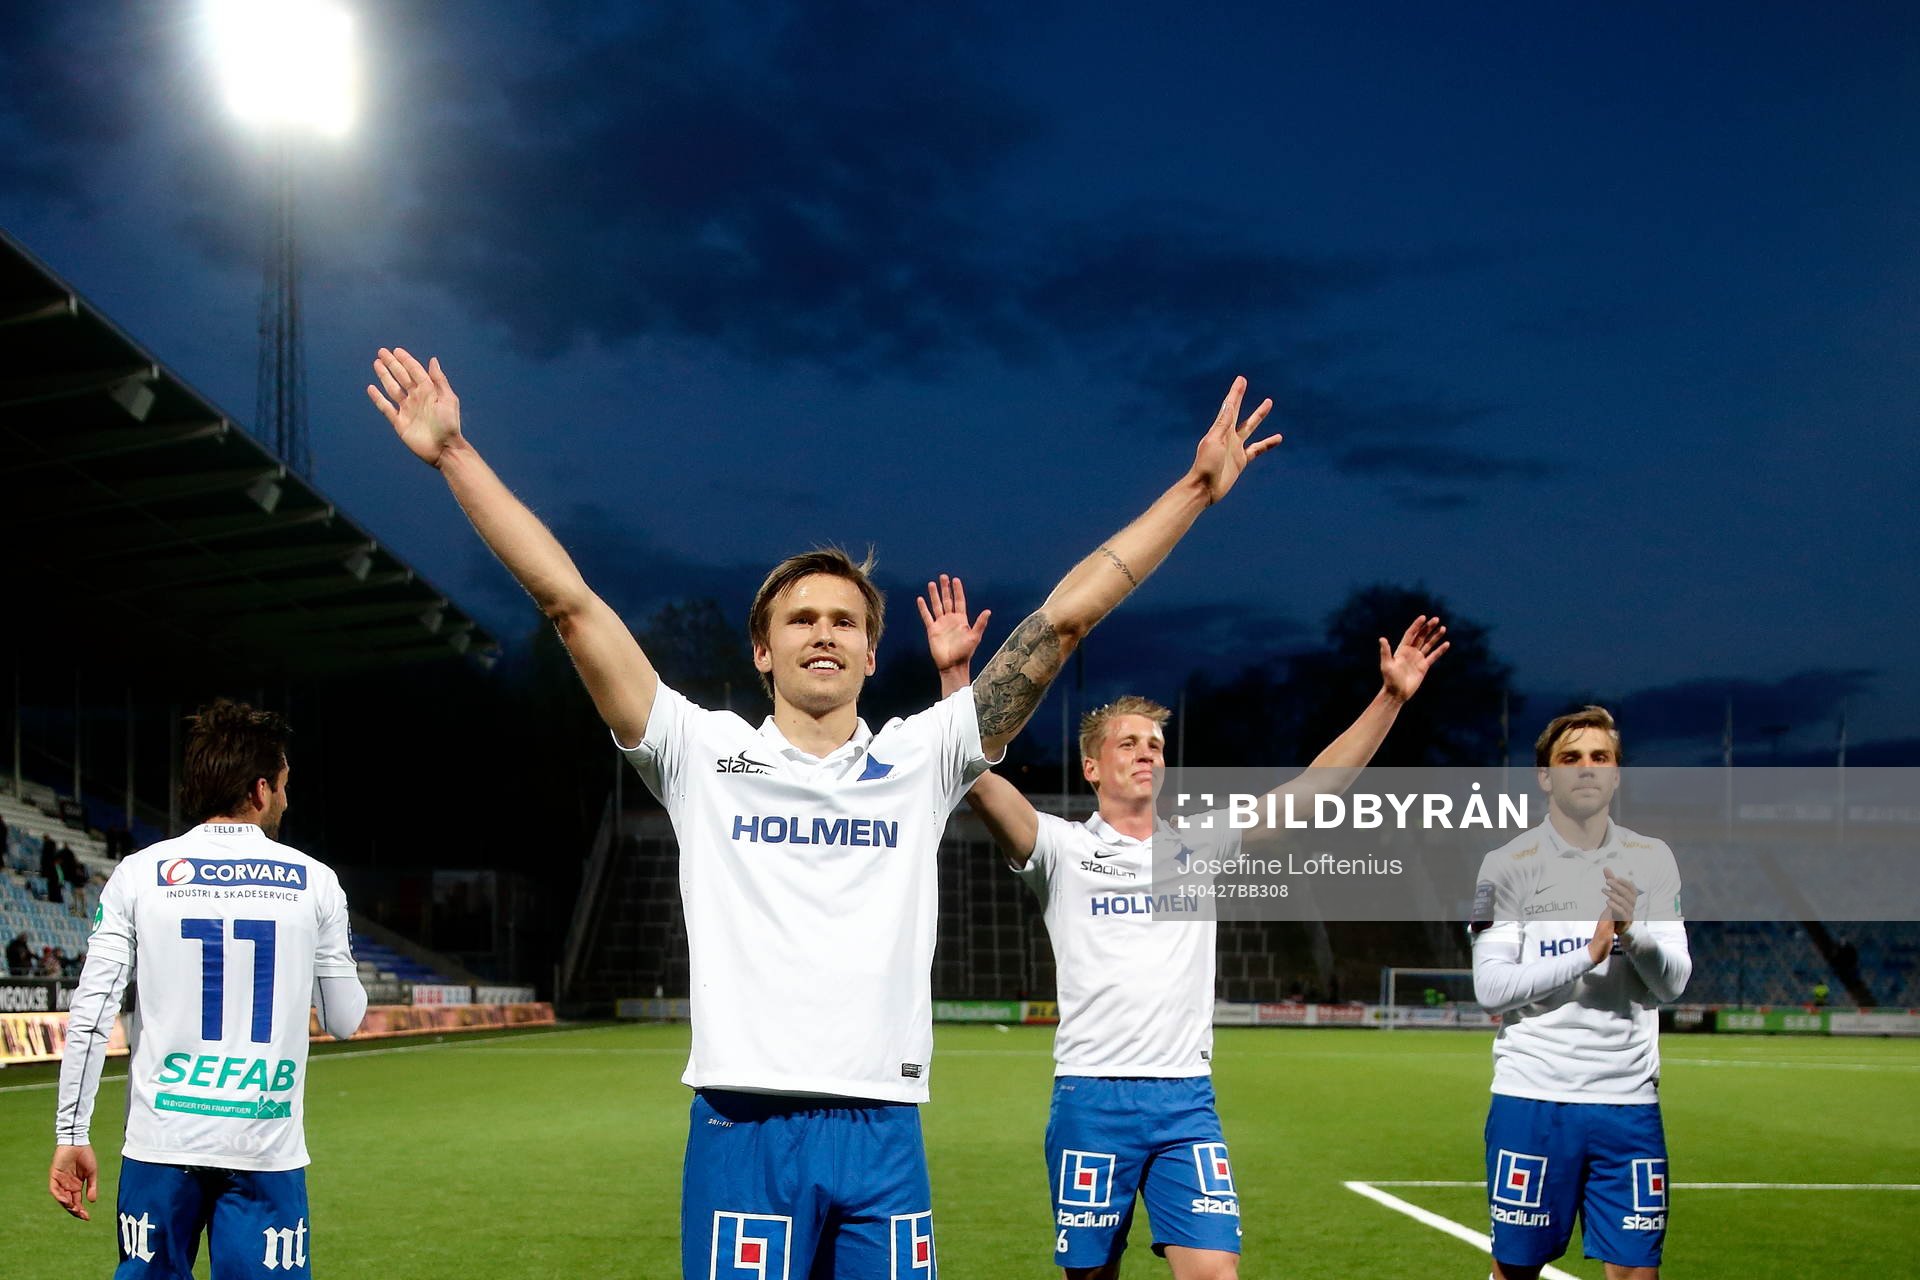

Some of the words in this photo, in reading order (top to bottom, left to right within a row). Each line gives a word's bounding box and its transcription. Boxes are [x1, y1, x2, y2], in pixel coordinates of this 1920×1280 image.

[214, 825, 235, 834] TELO
[732, 815, 898, 848] HOLMEN
[200, 864, 302, 884] CORVARA
[1080, 860, 1136, 879] stadium
[166, 889, 211, 899] INDUSTRI
[214, 890, 221, 899] &
[224, 890, 299, 902] SKADESERVICE
[1091, 893, 1199, 916] HOLMEN
[1524, 900, 1578, 916] stadium
[181, 918, 277, 1044] 11
[158, 1052, 297, 1092] SEFAB
[1057, 1208, 1120, 1228] tadium
[1057, 1228, 1069, 1254] 6
